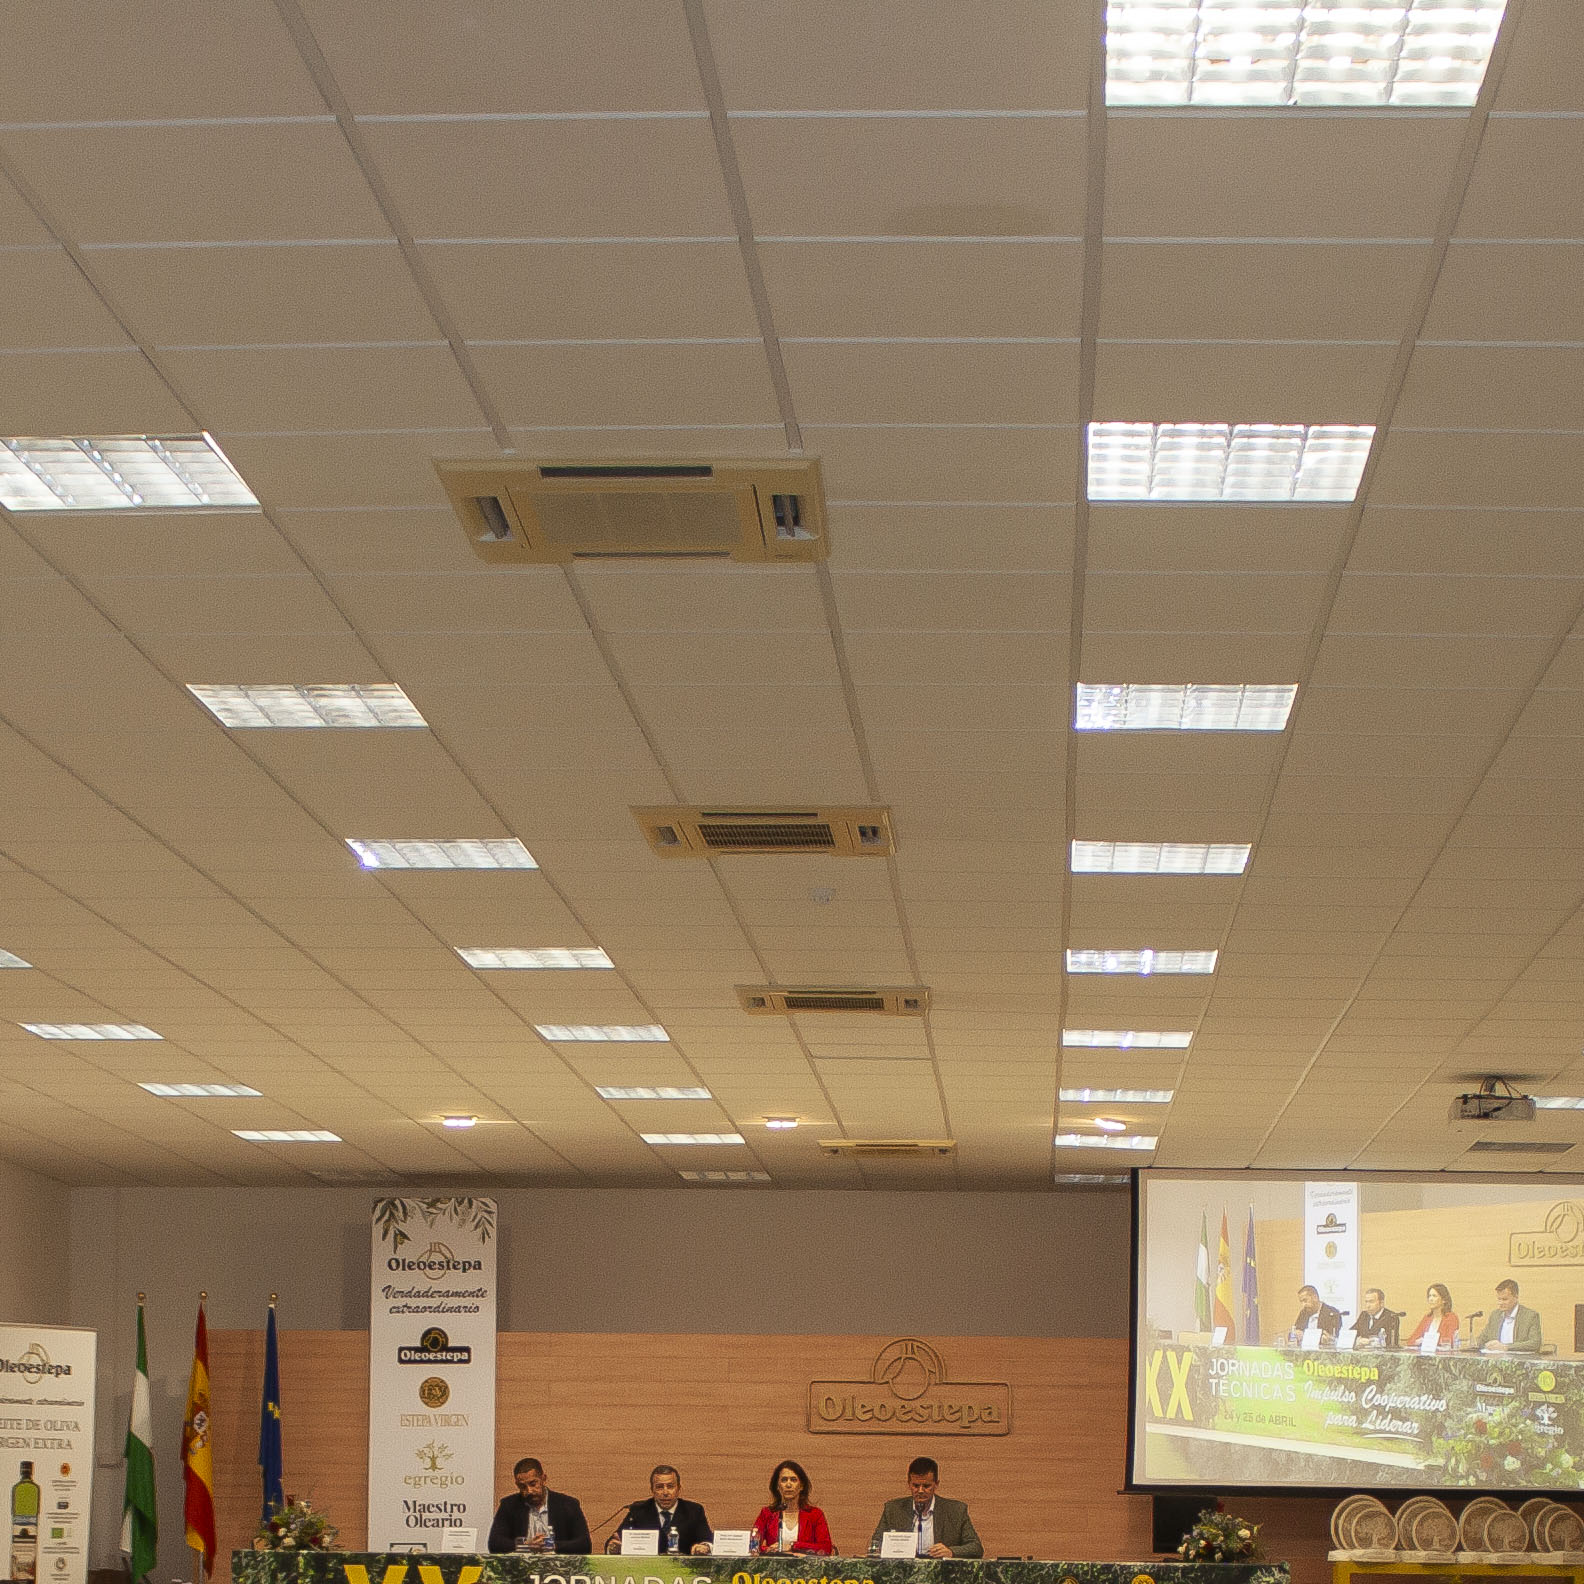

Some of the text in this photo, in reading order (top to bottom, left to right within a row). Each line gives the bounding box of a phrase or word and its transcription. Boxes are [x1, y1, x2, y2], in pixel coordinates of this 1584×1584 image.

[387, 1257, 482, 1273] Oleoestepa
[382, 1285, 488, 1300] Verdaderamente
[389, 1302, 480, 1315] extraordinario
[400, 1350, 469, 1361] Oleoestepa
[1208, 1358, 1294, 1381] JORNADAS
[1303, 1359, 1379, 1383] Oleoestepa
[1208, 1376, 1297, 1402] TÉCNICAS
[1303, 1380, 1356, 1404] Impulso
[1361, 1385, 1447, 1411] Cooperativo
[818, 1395, 1001, 1429] Oleoestepa
[1268, 1412, 1297, 1428] ABRIL
[400, 1413, 469, 1428] ESTEPA VIRGEN
[1325, 1410, 1420, 1434] para Liderar
[402, 1500, 467, 1514] Maestro
[406, 1514, 463, 1529] Oleario
